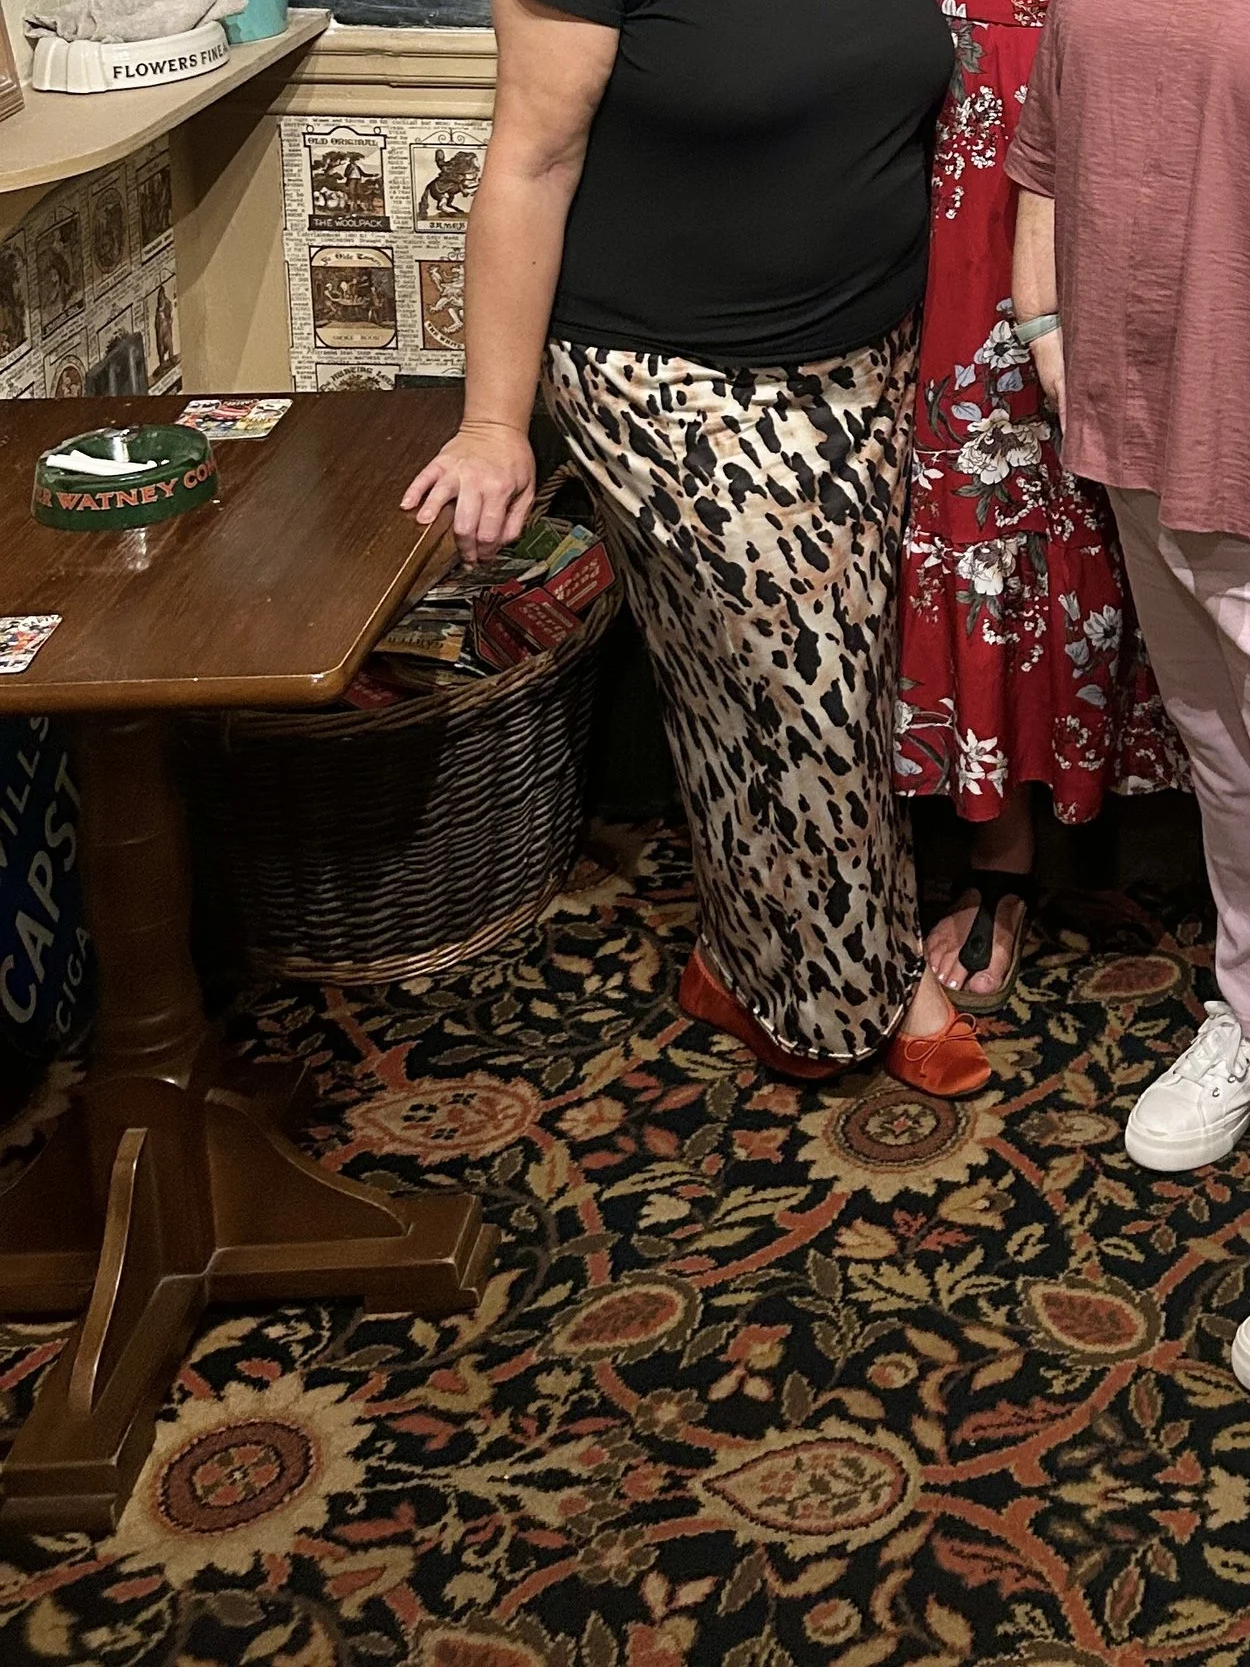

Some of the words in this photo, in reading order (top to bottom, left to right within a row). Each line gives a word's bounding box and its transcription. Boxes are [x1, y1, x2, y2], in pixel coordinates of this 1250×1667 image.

[113, 54, 198, 79] FLOWERS
[201, 45, 224, 66] FINE
[330, 139, 379, 147] ORIGINAL
[313, 218, 332, 227] THE
[335, 218, 384, 227] WOOLPACK
[56, 478, 179, 511] WATNEY
[0, 751, 80, 1024] CAPST
